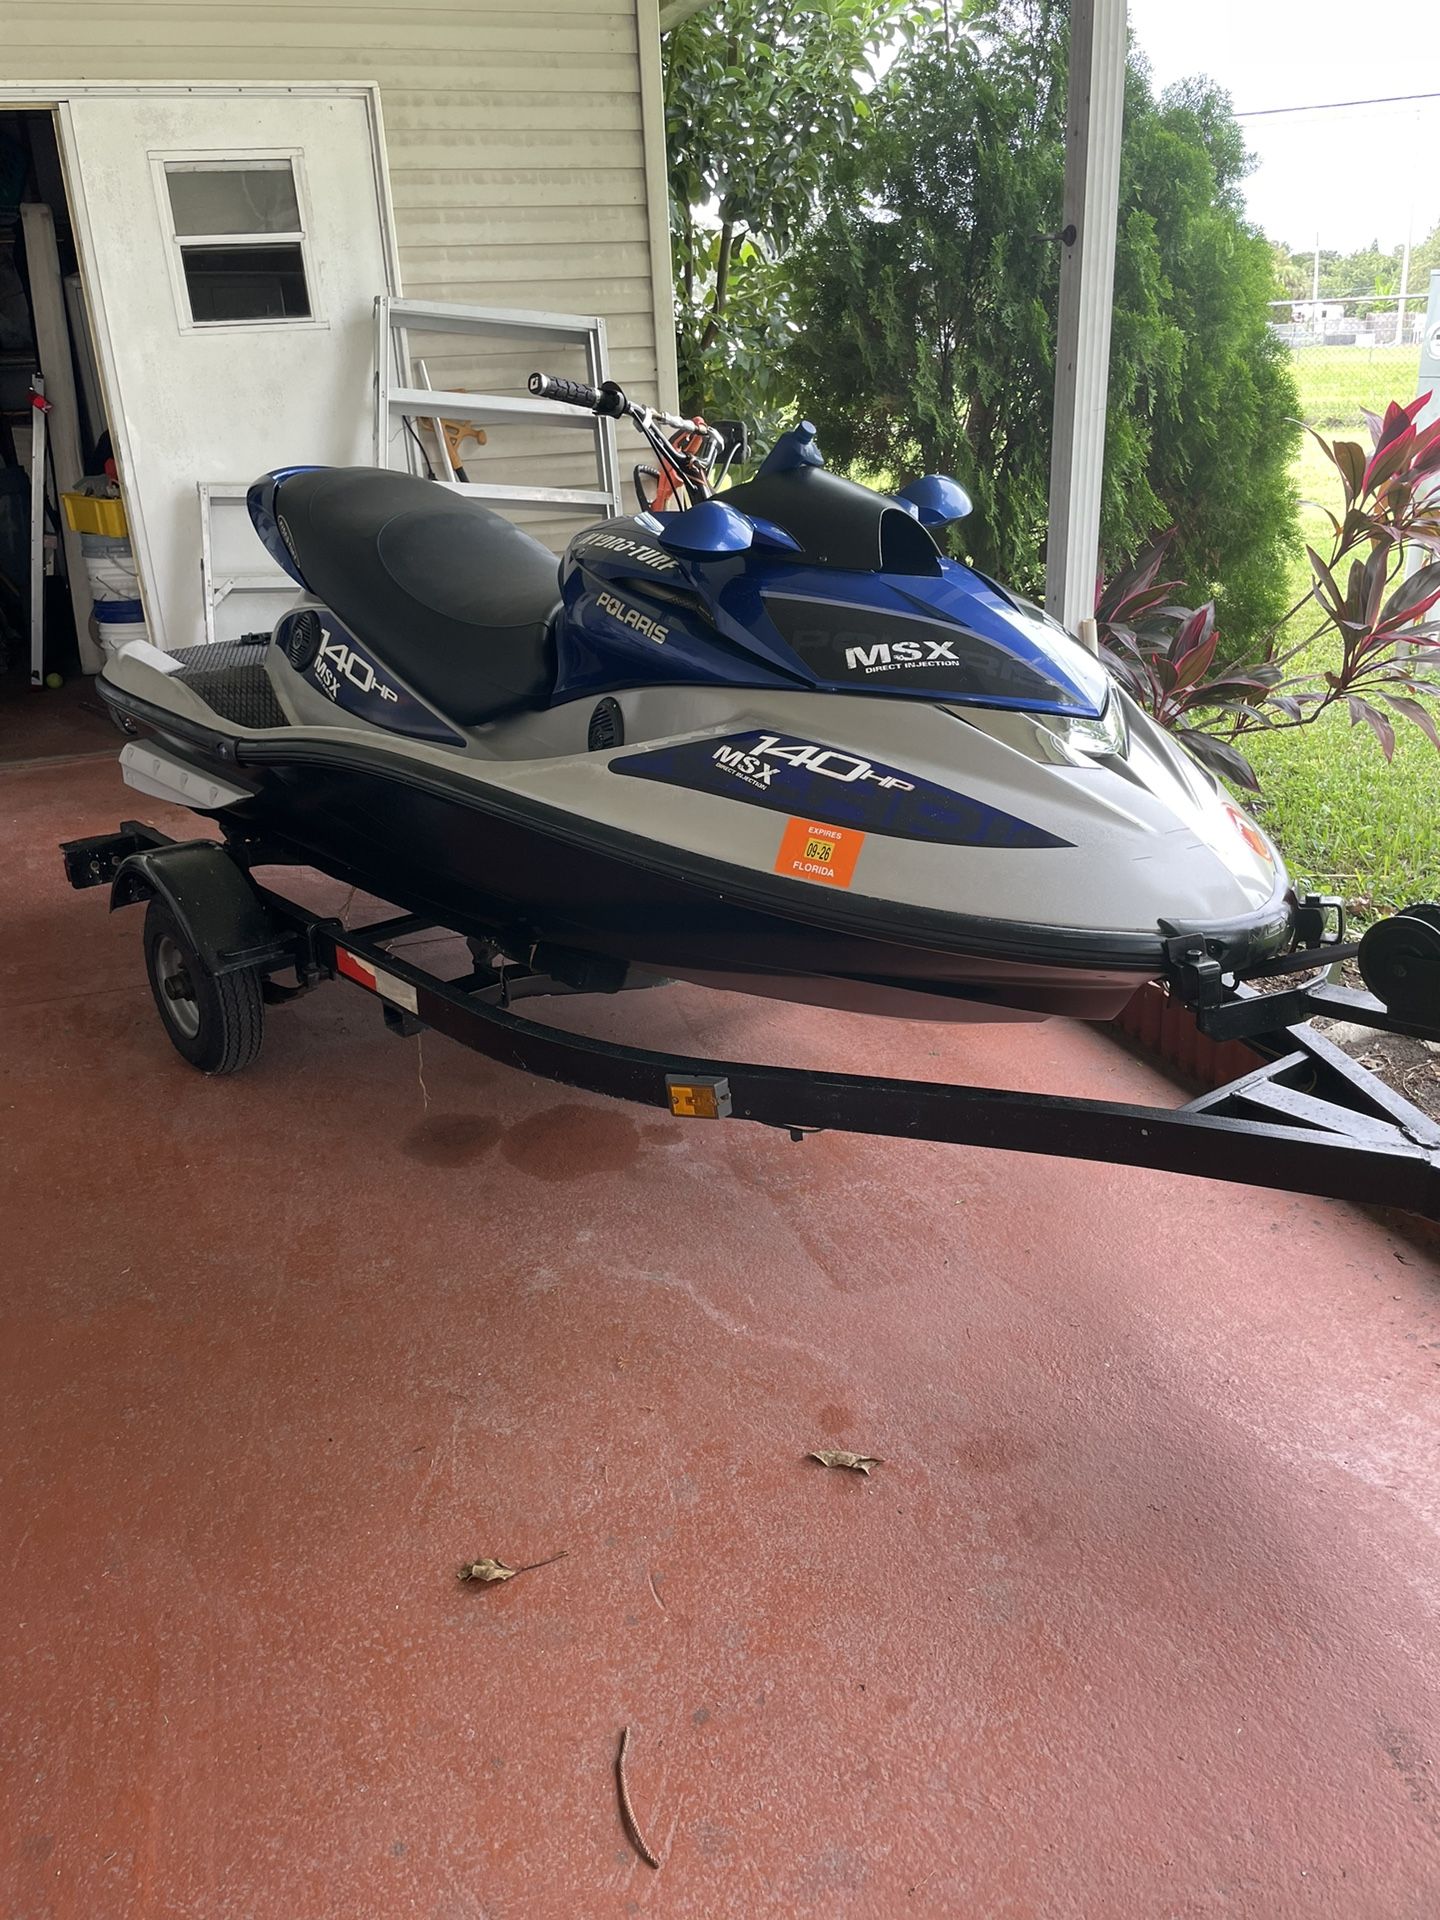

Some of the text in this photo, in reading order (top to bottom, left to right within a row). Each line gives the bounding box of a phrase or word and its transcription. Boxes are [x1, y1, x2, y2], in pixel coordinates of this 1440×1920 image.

[578, 533, 679, 571] HYDRO-TURF
[596, 592, 669, 645] POLARIS
[845, 641, 960, 670] MSX
[865, 660, 960, 674] DIRECT INJECTION
[313, 656, 341, 698] MSX
[711, 744, 781, 786] MSX
[808, 826, 843, 840] EXPIRES
[806, 842, 831, 861] 09-26
[792, 860, 834, 877] FLORIDA
